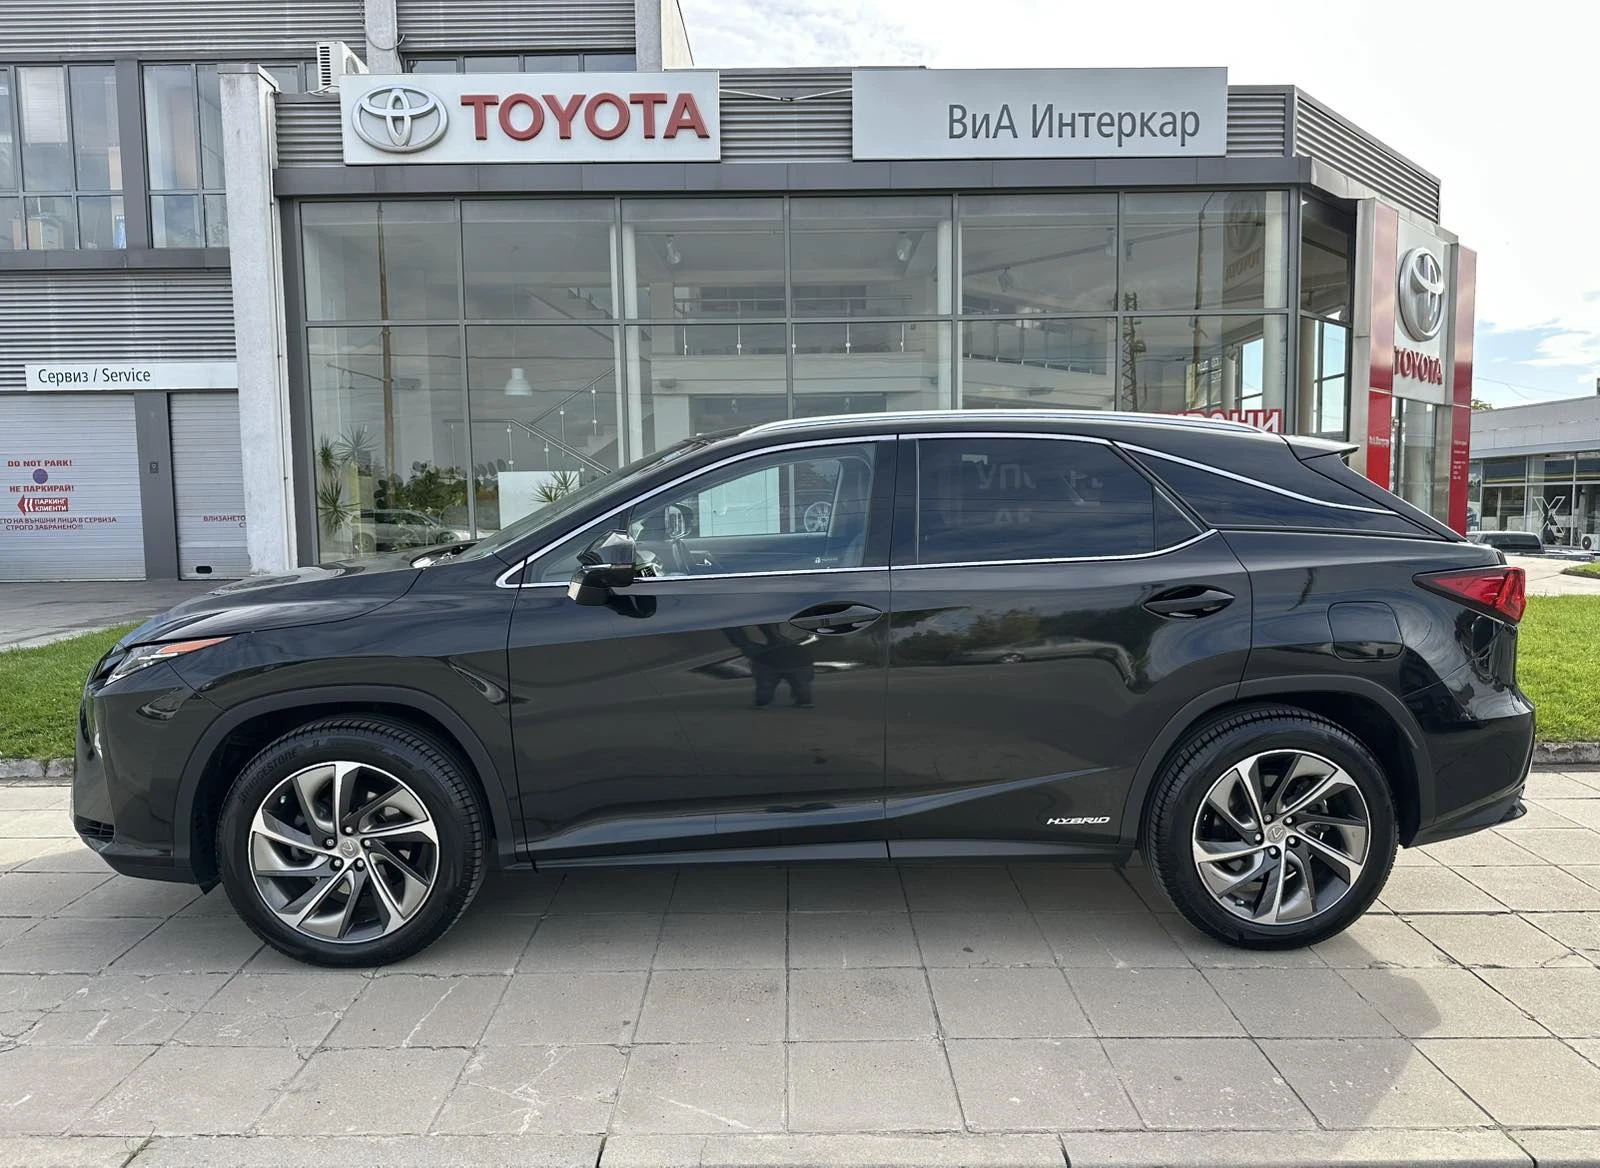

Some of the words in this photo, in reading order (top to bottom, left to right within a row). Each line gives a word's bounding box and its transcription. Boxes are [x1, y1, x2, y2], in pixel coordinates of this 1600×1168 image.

[460, 92, 710, 142] TOYOTA
[948, 104, 1018, 139] ВиА
[1031, 104, 1200, 147] Интеркар
[38, 368, 88, 386] Сервиз
[102, 368, 151, 382] Service
[1394, 346, 1442, 385] TOYOTA
[1047, 816, 1110, 825] HYBRID
